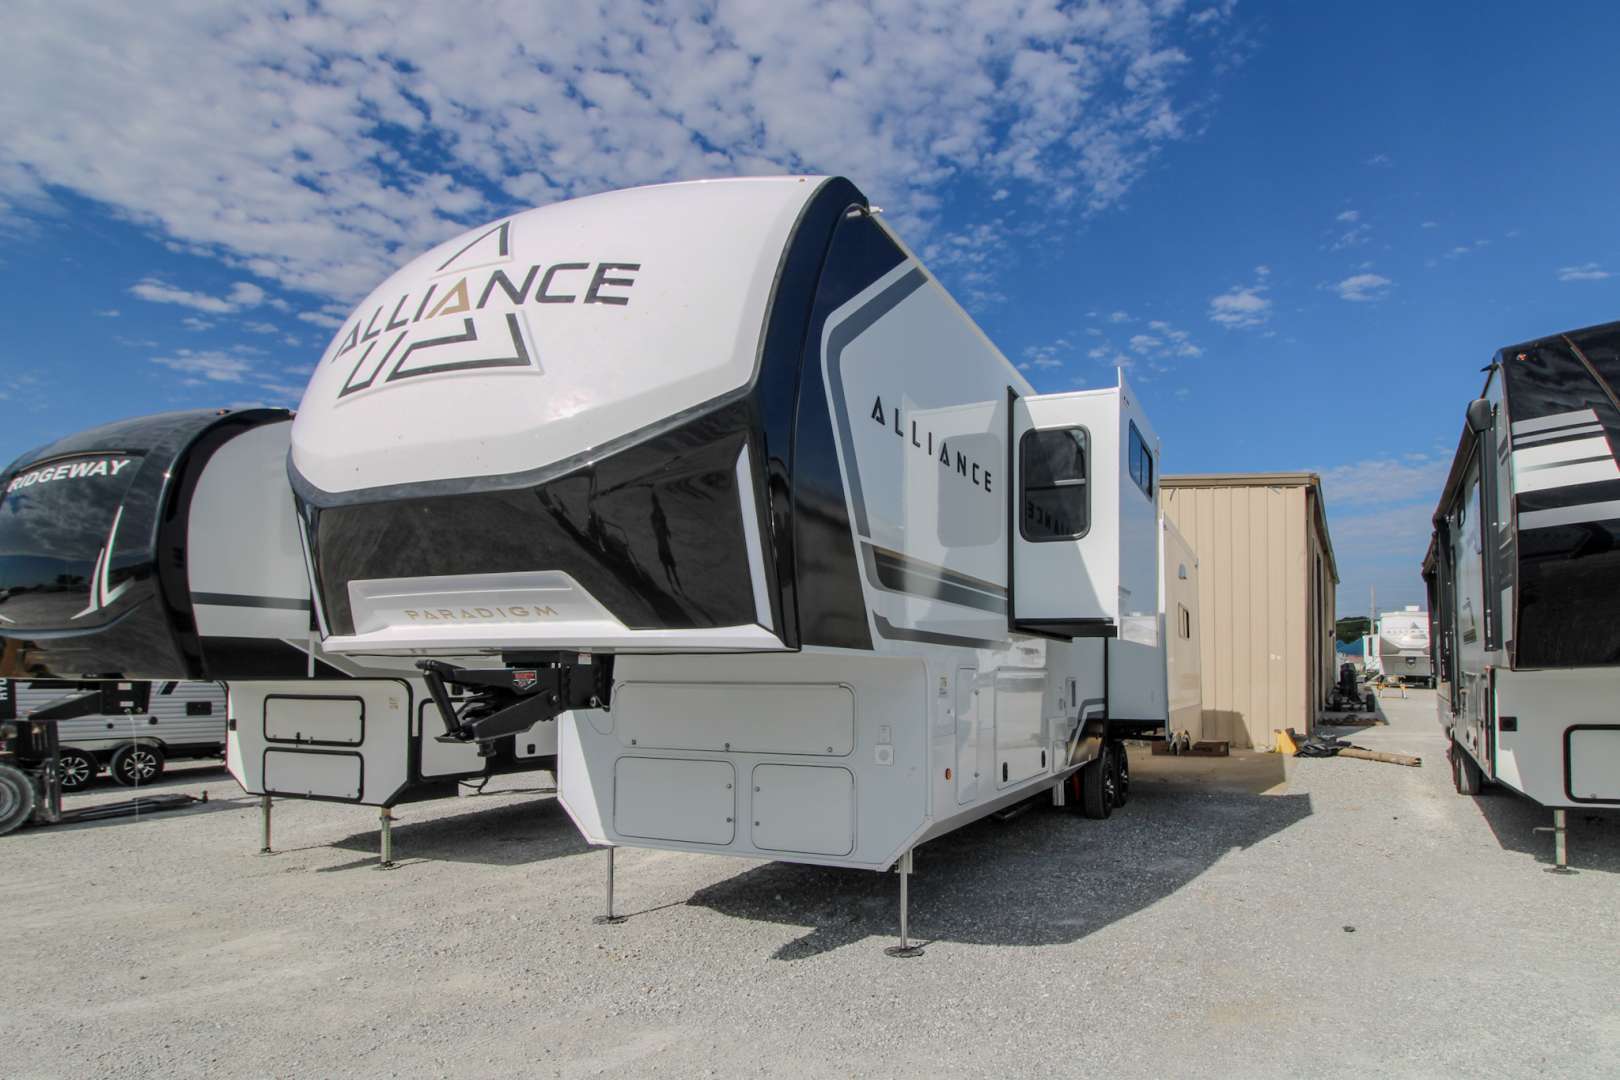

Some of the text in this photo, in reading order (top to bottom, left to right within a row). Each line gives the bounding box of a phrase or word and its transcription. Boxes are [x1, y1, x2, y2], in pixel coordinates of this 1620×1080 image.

[332, 262, 642, 362] ALLIANCE
[6, 459, 130, 493] RIDGEWAY
[871, 395, 992, 493] ALLIANCE
[404, 605, 559, 620] PARADIGM
